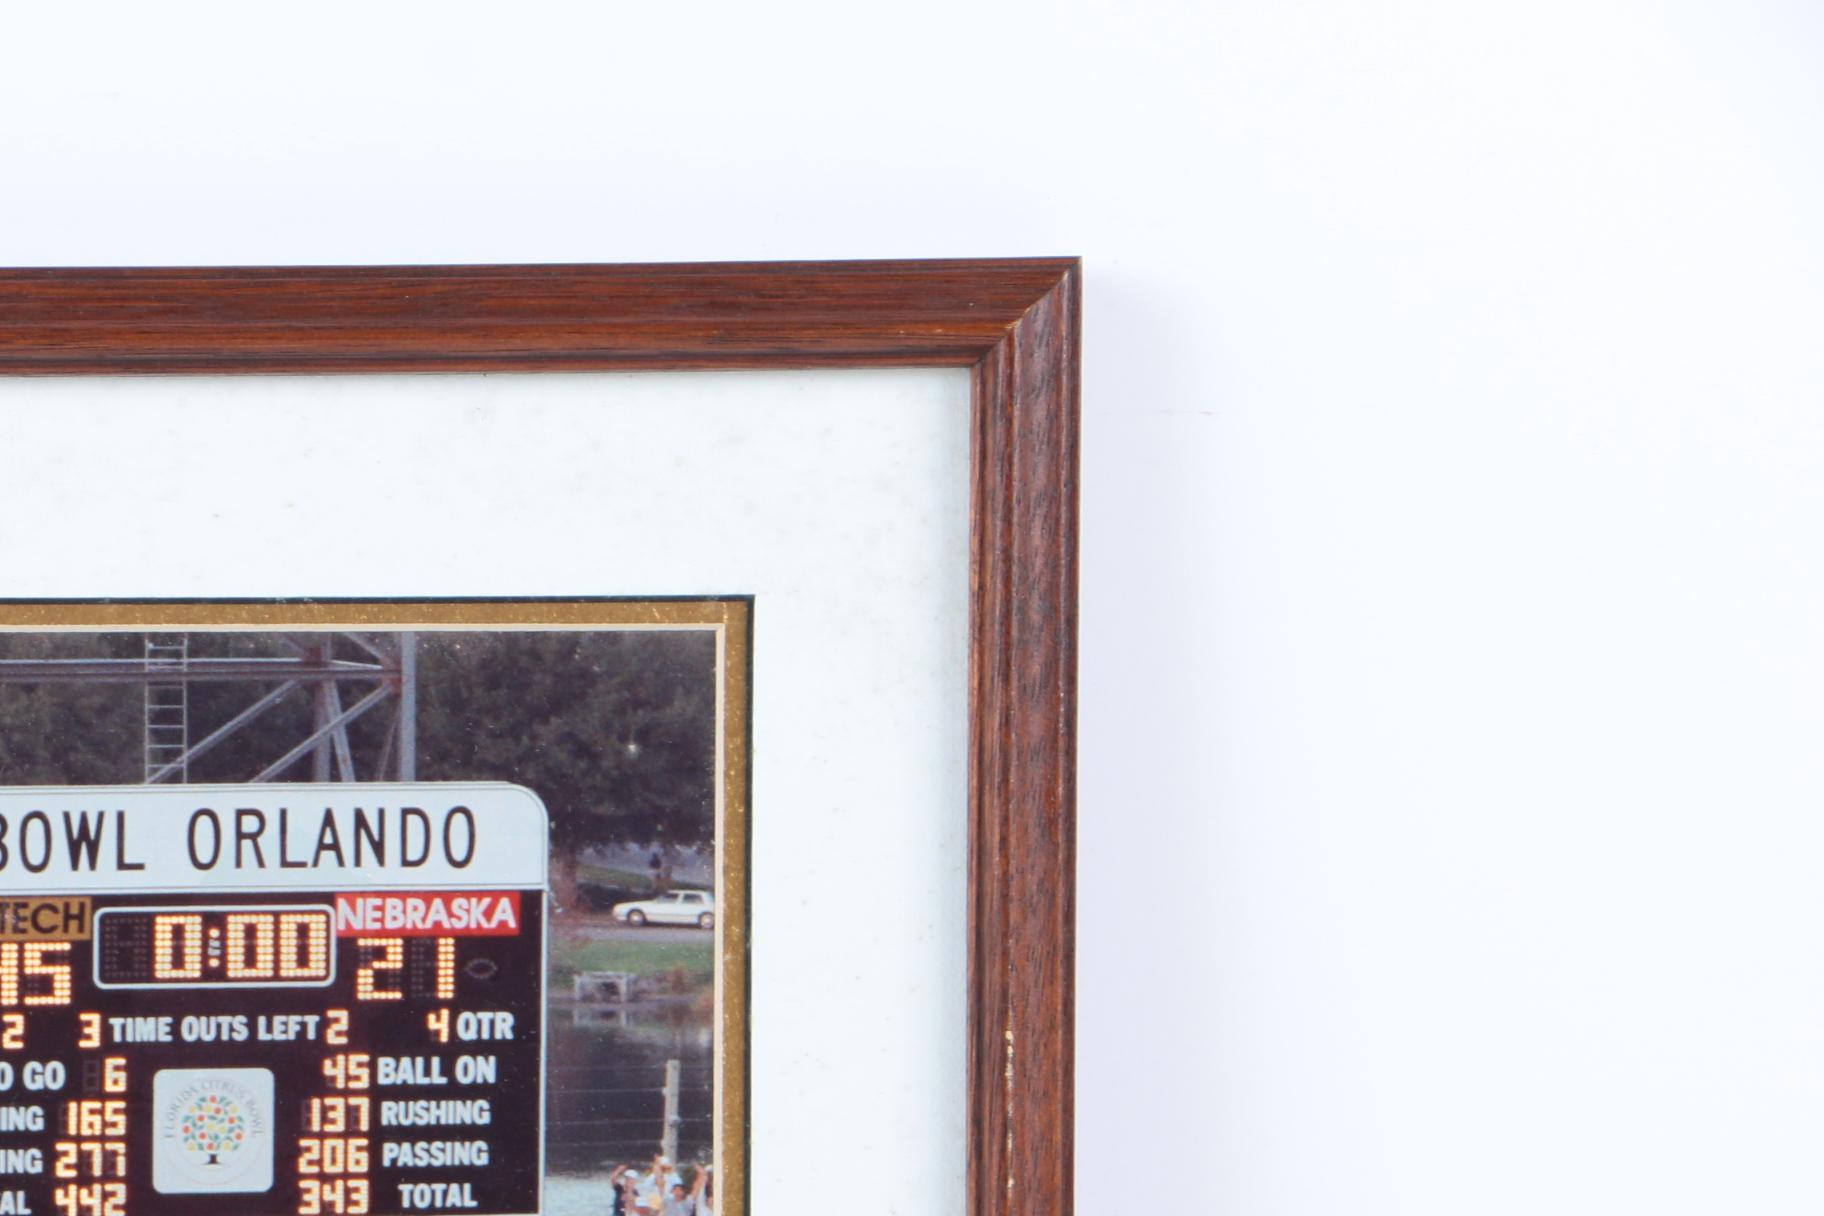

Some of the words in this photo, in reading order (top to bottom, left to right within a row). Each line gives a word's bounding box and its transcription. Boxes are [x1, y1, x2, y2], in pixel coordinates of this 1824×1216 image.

[187, 806, 477, 872] ORLANDO
[336, 896, 518, 931] NEBRASKA
[153, 914, 328, 979] 0:00
[356, 937, 455, 1001] 21
[1, 1013, 25, 1050] 2
[78, 1012, 102, 1049] 3
[108, 1016, 174, 1043] TIME
[180, 1015, 250, 1043] OUTS
[257, 1014, 321, 1041] LEFT
[325, 1008, 350, 1046] 2
[427, 1008, 450, 1043] 4
[456, 1010, 516, 1041] QTR
[22, 1060, 67, 1091] GO
[103, 1056, 127, 1093] 6
[323, 1053, 370, 1090] 45
[377, 1056, 449, 1086] BALL
[455, 1054, 497, 1085] ON
[67, 1100, 127, 1137] 165
[310, 1096, 370, 1133] 137
[380, 1099, 492, 1127] RUSHING
[54, 1141, 127, 1178] 277
[297, 1138, 370, 1174] 206
[381, 1140, 490, 1168] PASSING
[297, 1178, 370, 1216] 343
[397, 1182, 479, 1209] TOTAL
